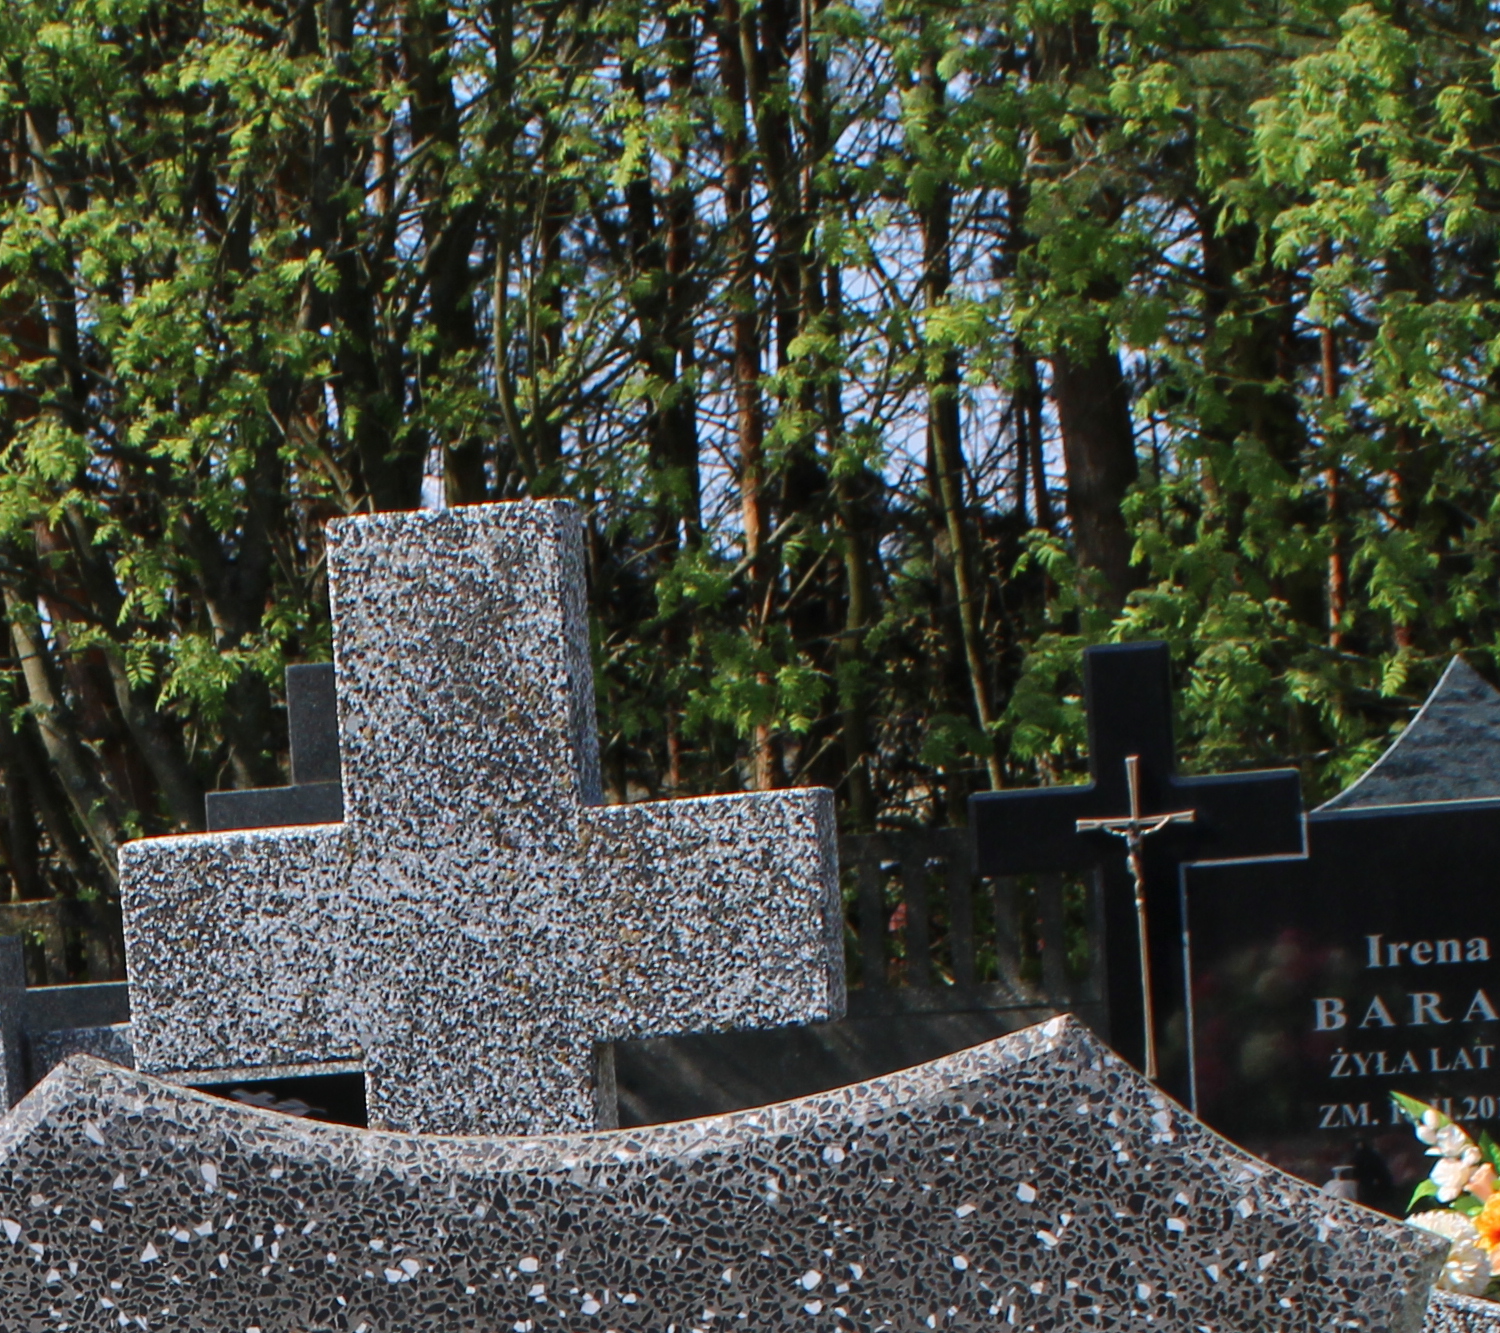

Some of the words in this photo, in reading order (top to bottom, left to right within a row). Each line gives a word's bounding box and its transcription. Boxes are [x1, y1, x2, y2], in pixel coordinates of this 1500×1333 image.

[1366, 933, 1492, 968] Irena
[1330, 1047, 1421, 1078] ŻYŁA
[1429, 1045, 1495, 1072] LAT
[1319, 1102, 1379, 1128] ZM.
